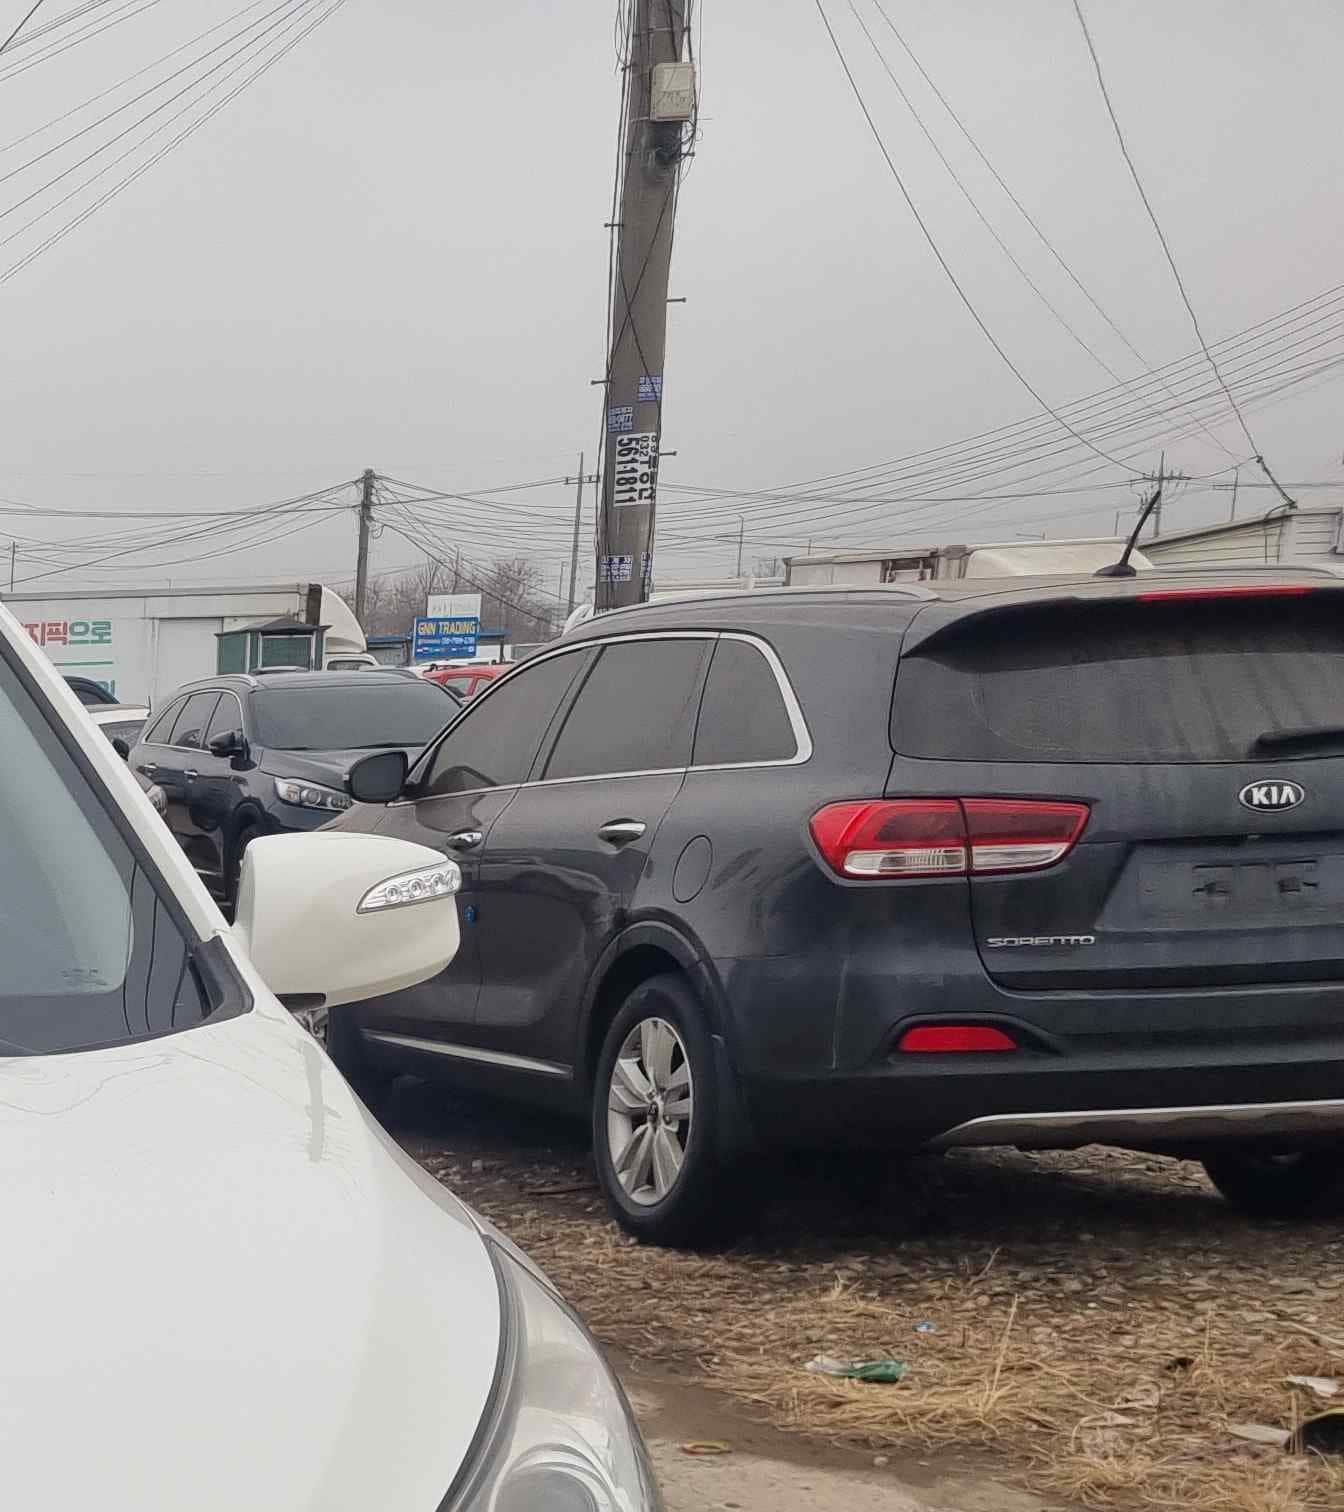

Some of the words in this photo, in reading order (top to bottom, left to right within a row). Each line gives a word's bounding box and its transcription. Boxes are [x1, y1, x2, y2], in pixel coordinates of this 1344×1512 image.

[20, 620, 113, 646] 지픽으로
[1251, 786, 1297, 805] KIA
[986, 934, 1096, 948] SORENTO
